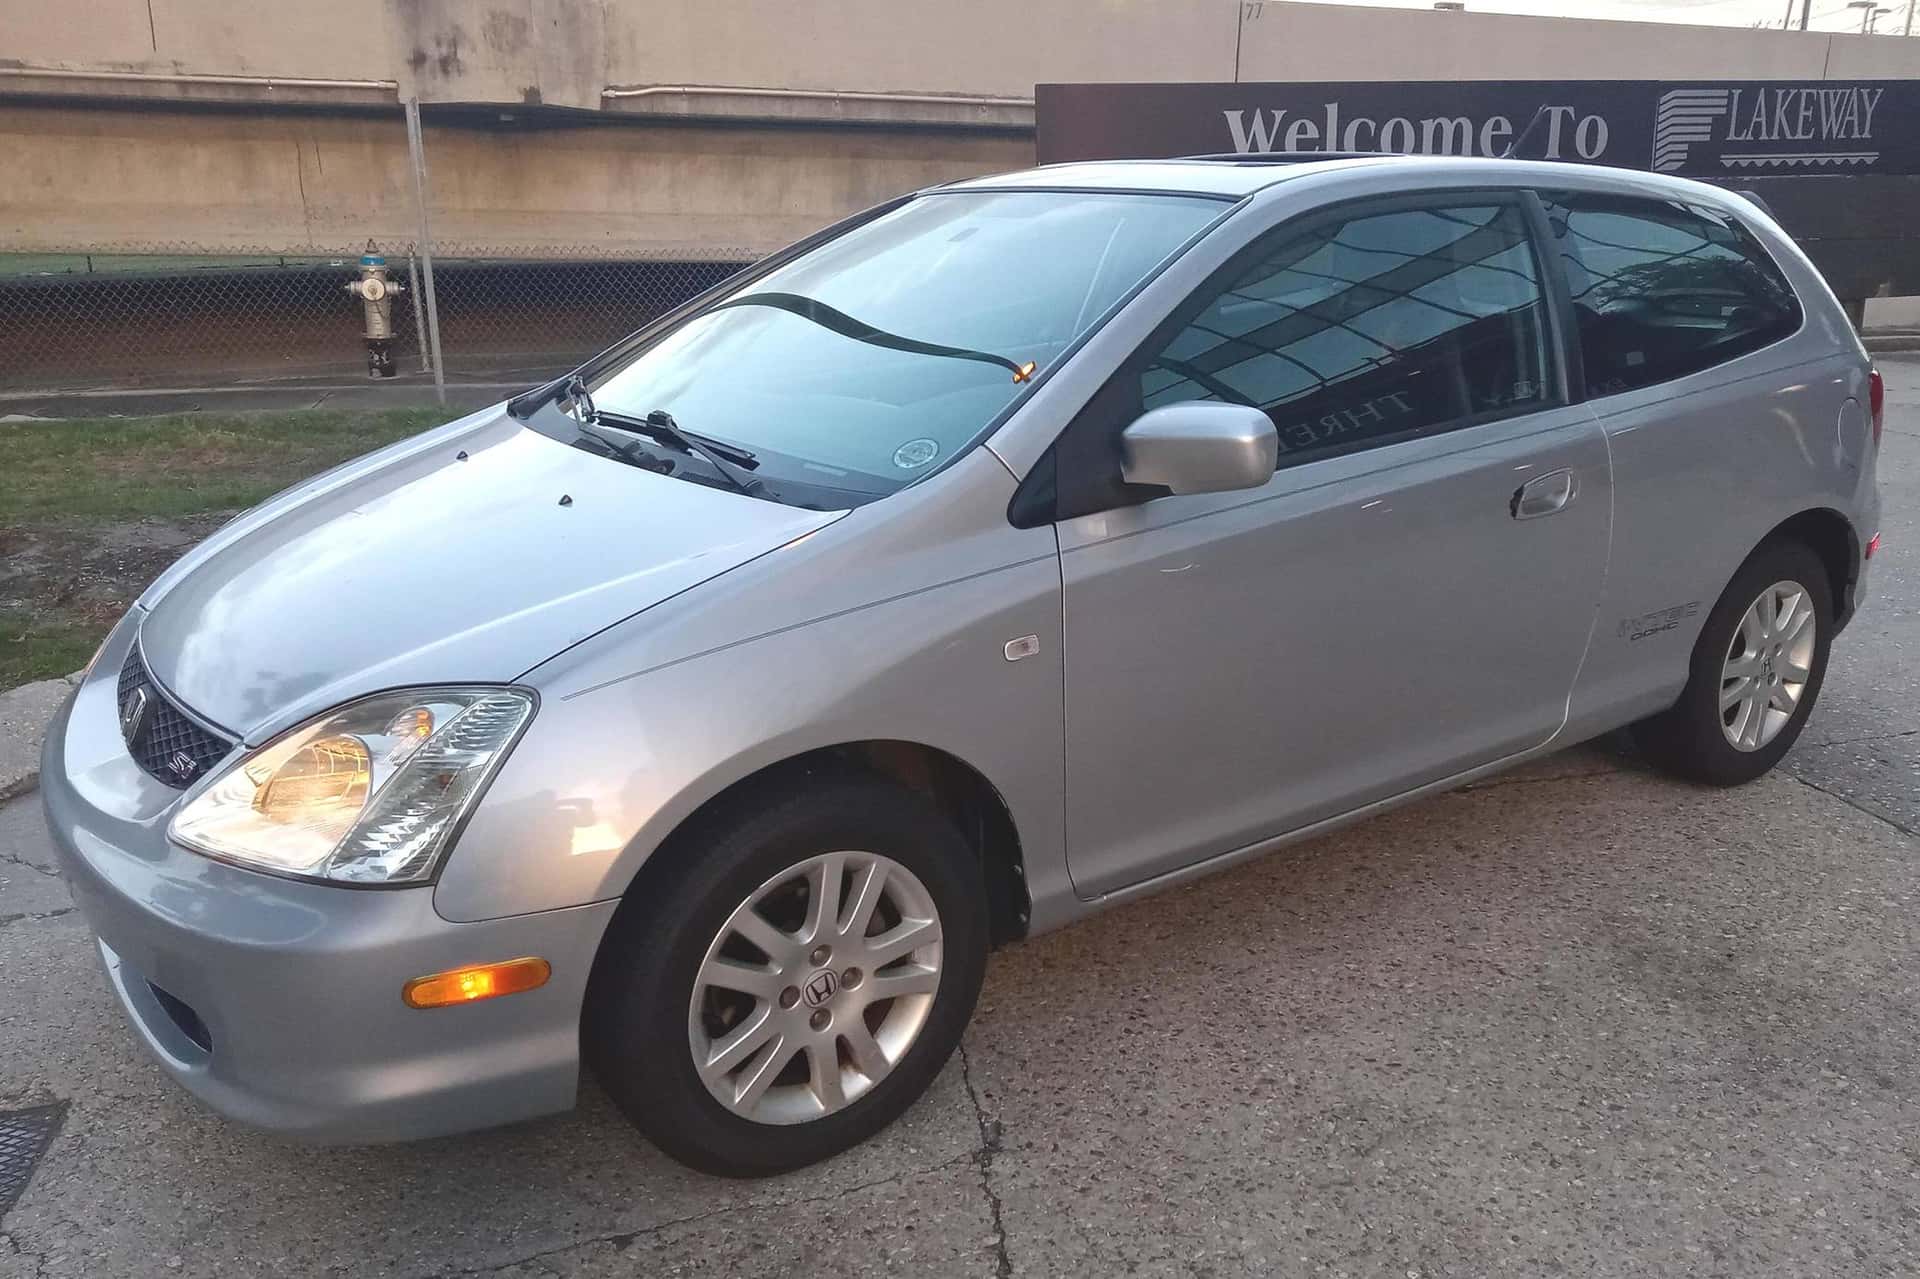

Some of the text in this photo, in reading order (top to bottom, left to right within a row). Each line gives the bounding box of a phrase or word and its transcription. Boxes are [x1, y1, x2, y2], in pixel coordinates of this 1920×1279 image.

[1246, 2, 1263, 20] 77
[1224, 102, 1609, 160] Welcome To
[1726, 87, 1884, 141] LAKEWAY
